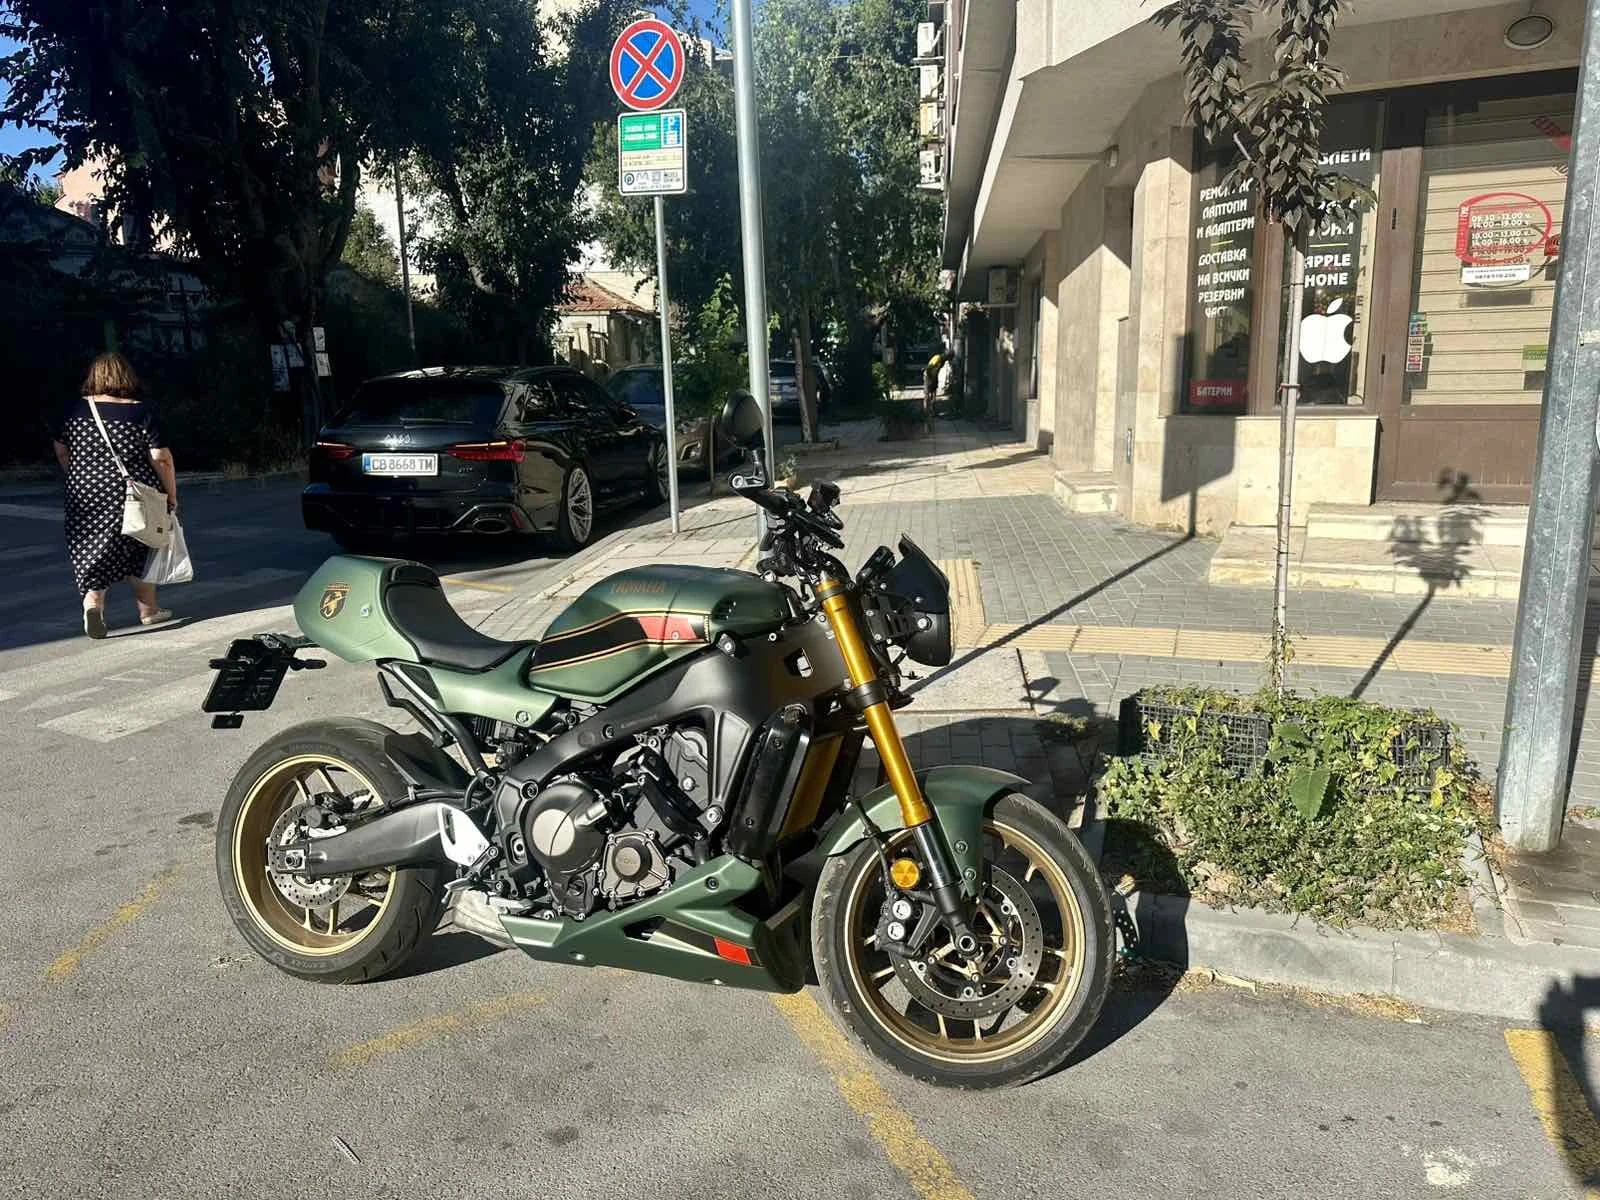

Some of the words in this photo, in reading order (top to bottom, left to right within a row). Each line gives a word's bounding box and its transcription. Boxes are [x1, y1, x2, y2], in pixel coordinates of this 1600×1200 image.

[1202, 198, 1248, 219] ЛАПТОПИ
[1196, 226, 1204, 239] И
[1205, 216, 1255, 239] АДАПТЕРИ
[1198, 247, 1248, 267] ДОСТАВКА
[1304, 253, 1352, 269] APPLE
[1197, 273, 1211, 287] НА
[1212, 268, 1250, 284] ВСИЧКИ
[1198, 288, 1246, 303] РЕЗЕРВНИ
[1204, 305, 1232, 319] ЧАСТ
[372, 458, 387, 470] CB
[389, 458, 416, 470] 8668
[418, 458, 433, 470] TM
